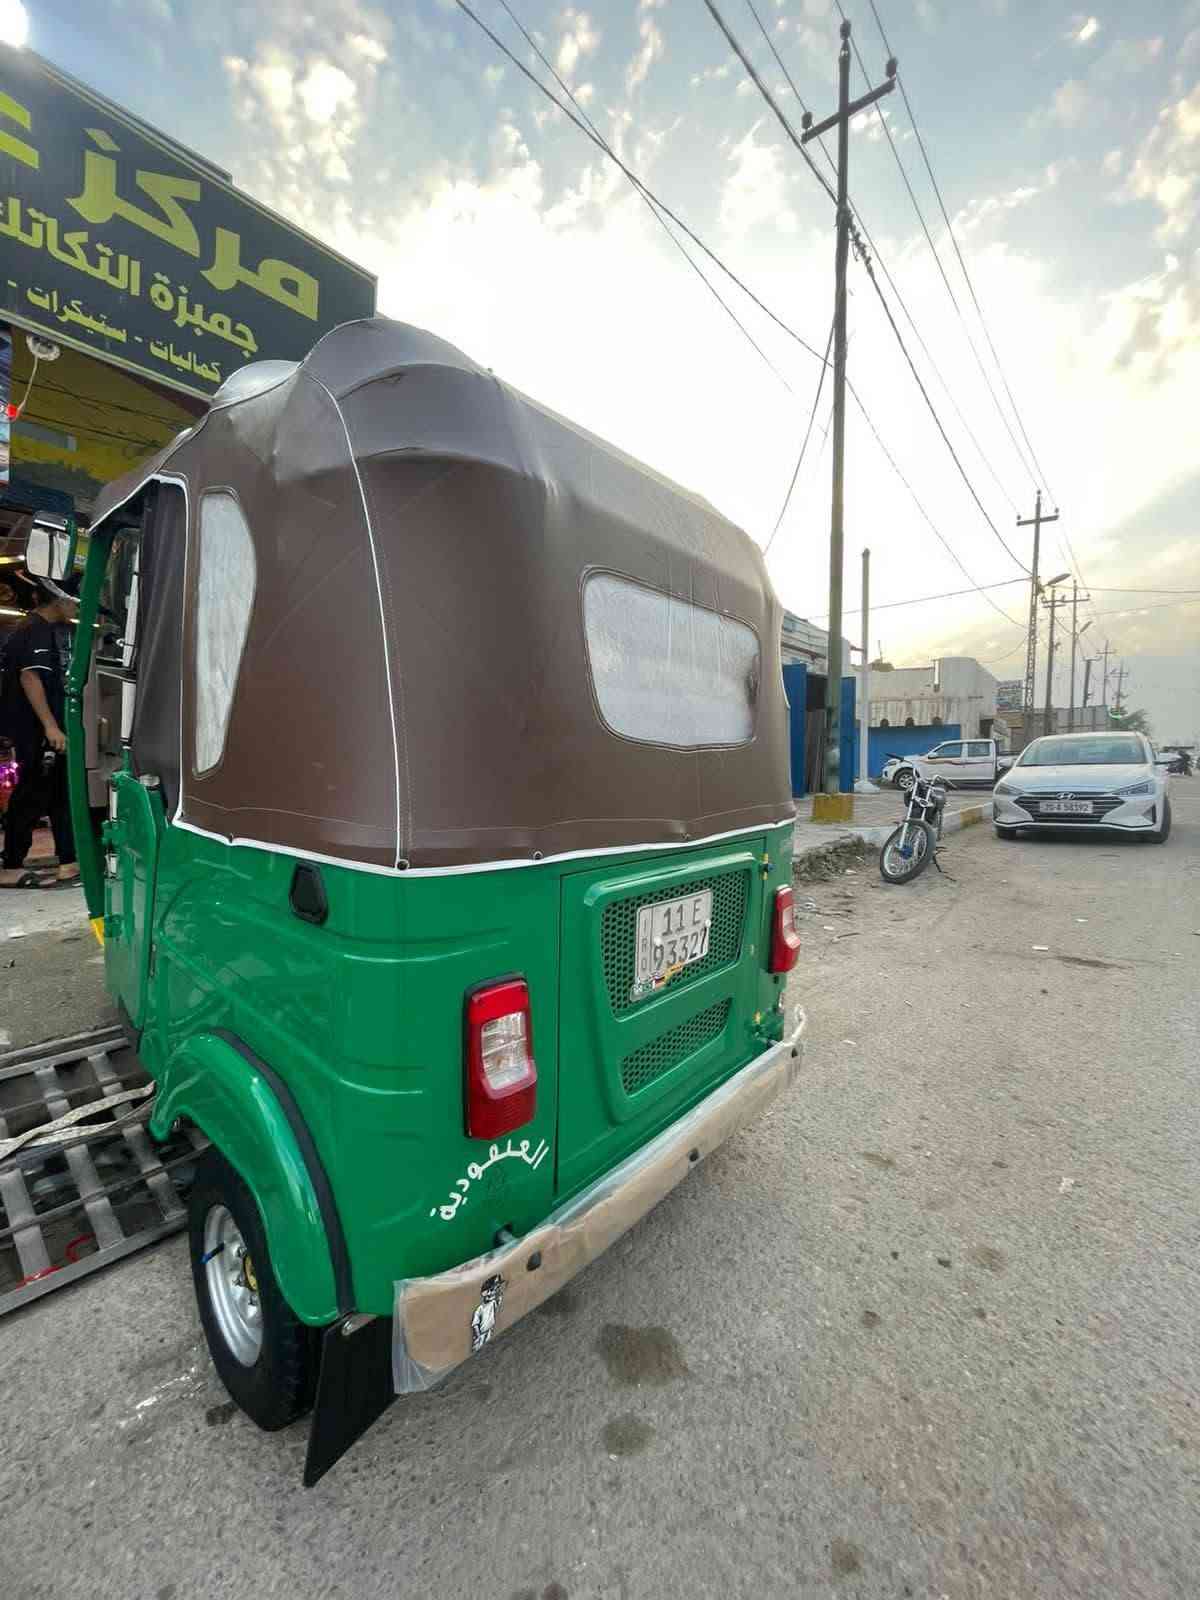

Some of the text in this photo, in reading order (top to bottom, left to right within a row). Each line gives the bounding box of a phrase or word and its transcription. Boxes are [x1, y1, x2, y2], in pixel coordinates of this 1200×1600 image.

[65, 127, 319, 321] مركز
[26, 287, 127, 342] ستيكرات
[150, 340, 221, 382] كماليات
[662, 899, 703, 936] 11 E
[654, 926, 708, 971] 93327
